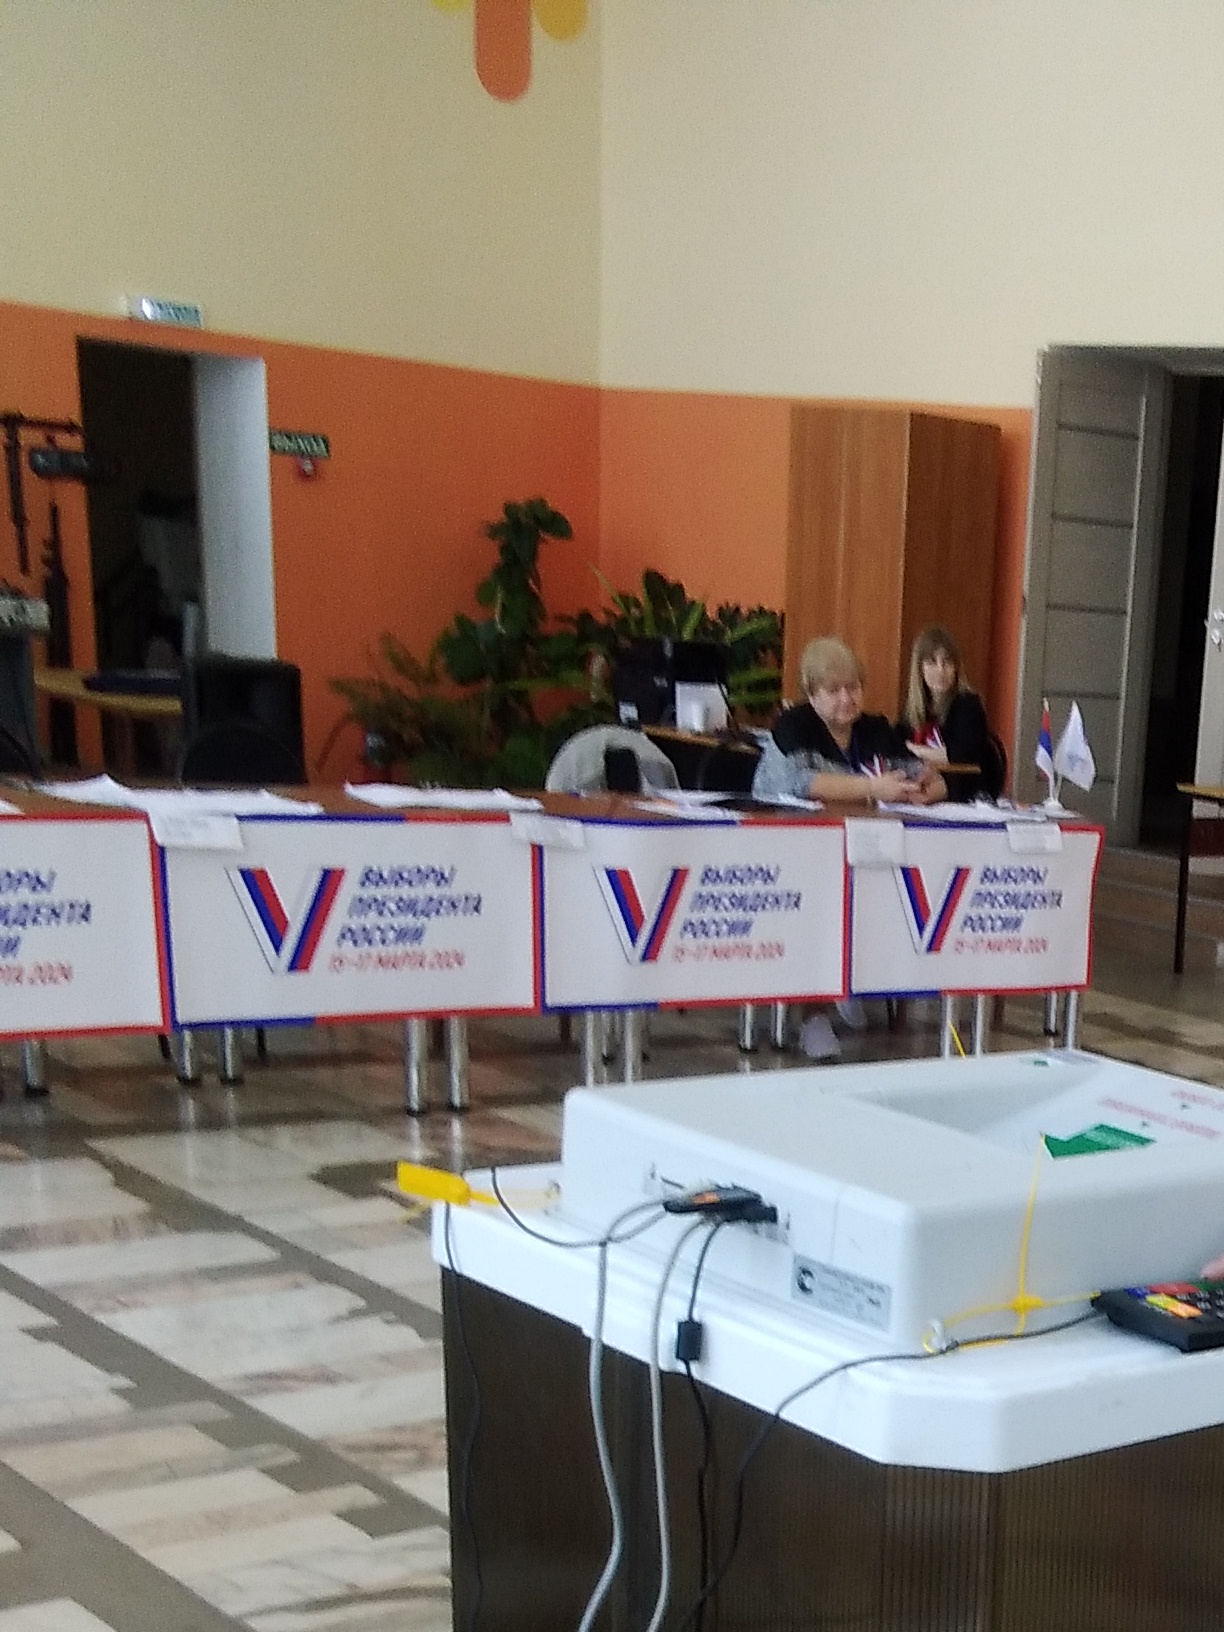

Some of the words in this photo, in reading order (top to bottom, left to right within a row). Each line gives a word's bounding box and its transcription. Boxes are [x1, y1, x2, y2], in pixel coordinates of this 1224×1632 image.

[359, 866, 457, 888] ВЫБОРЫ
[700, 865, 781, 886] ВЫБОРЫ
[980, 866, 1049, 885] ВЫБОРЫ
[348, 893, 483, 920] ПРЕЗИДЕНТА
[689, 890, 802, 915] ПРЕЗИДЕНТА
[970, 889, 1063, 911] ПРЕЗИДЕНТА
[680, 918, 754, 939] РОССИИ
[961, 915, 1024, 934] РОССИИ
[337, 925, 426, 948] РОССИИ
